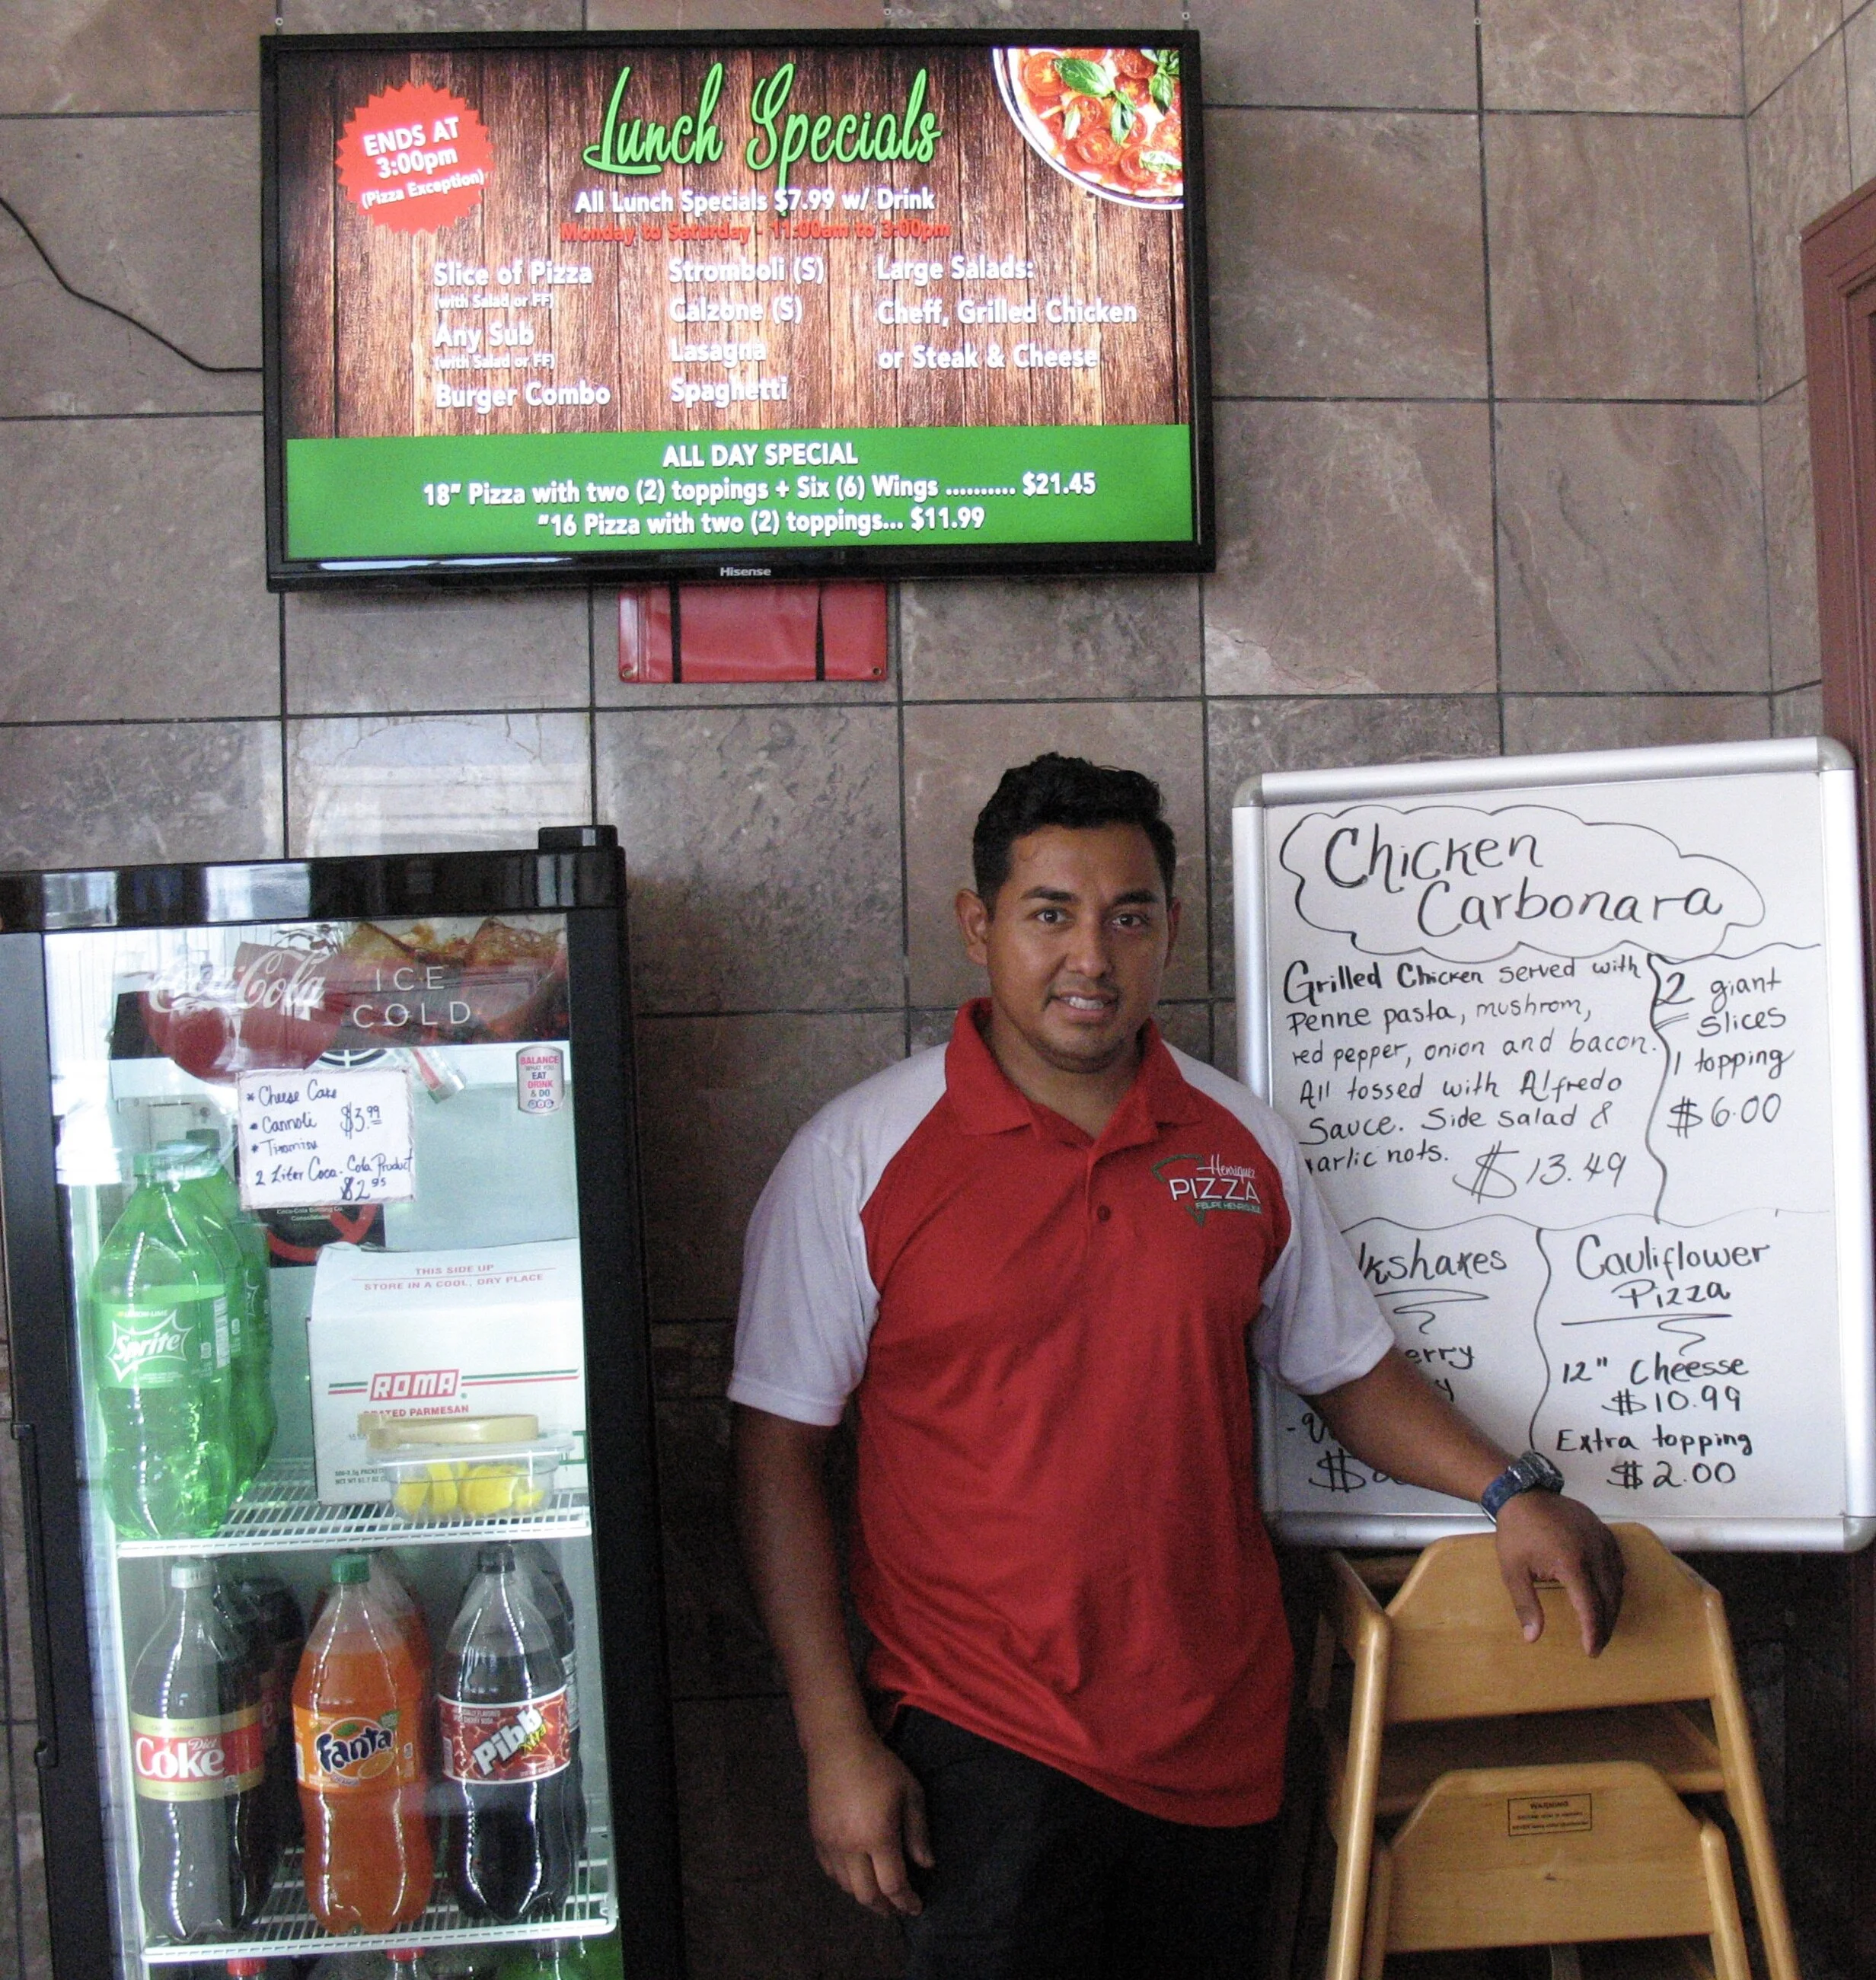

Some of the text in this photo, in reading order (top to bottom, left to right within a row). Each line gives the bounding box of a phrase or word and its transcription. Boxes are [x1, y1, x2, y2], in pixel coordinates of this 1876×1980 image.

[363, 116, 460, 158] ENDS AT
[583, 62, 941, 217] Lunch Specials
[376, 147, 458, 180] 3:00pm
[361, 170, 484, 209] (Pizza Exception)
[575, 187, 935, 216] All Lunch Specials $7.99 w/ Drink
[562, 220, 951, 246] Monday to Saturday 11:00am to 3:00pm
[432, 260, 592, 287] Slice of Pizza
[668, 257, 825, 285] Stromboli (S)
[876, 255, 1035, 287] Large Salads:
[434, 292, 555, 311] (with Salad or FF)
[668, 294, 802, 324] Calzone (S)
[877, 298, 1137, 327] Cheff, Grilled Chicken
[434, 320, 534, 353] Any Sub
[434, 353, 556, 371] (with Salad or FF)
[670, 339, 767, 368] Lasagna
[879, 344, 1098, 370] or Steak & Cheese
[436, 381, 610, 414] Burger Combo
[670, 377, 787, 408] Spaghetti
[663, 442, 859, 468] ALL DAY SPECIAL
[468, 482, 525, 505] Pizza
[532, 480, 579, 505] with
[586, 480, 629, 503] two
[636, 479, 665, 505] (2)
[672, 477, 768, 506] toppings
[776, 483, 790, 498] +
[797, 475, 830, 499] Six
[837, 475, 865, 501] (6)
[872, 473, 939, 502] Wings
[1023, 471, 1096, 498] $21.45
[585, 513, 640, 537] Pizza
[648, 511, 694, 534] with
[701, 512, 744, 534] two
[751, 510, 780, 537] (2)
[911, 506, 985, 531] $11.99
[719, 566, 771, 576] Hisense
[1325, 824, 1543, 893] Chicken
[1417, 876, 1723, 937] Carbonara
[376, 966, 446, 991] ICE
[1283, 955, 1642, 1007] Grilled Chicken served with
[1657, 967, 1782, 1014] 2 giant
[353, 1000, 471, 1028] COLD
[1384, 998, 1466, 1035] pasta,
[520, 1056, 560, 1064] BALANCE
[1292, 1028, 1657, 1069] red pepper, onion and bacon.
[1674, 1047, 1795, 1080] 1 topping
[259, 1085, 299, 1106] Cheese
[1300, 1068, 1622, 1109] All tossed with Alfredo
[263, 1111, 317, 1133] Cannoli
[1421, 1107, 1487, 1132] Side
[1667, 1092, 1782, 1139] $6.00
[1305, 1145, 1377, 1176] arlic
[1387, 1140, 1449, 1165] nots.
[255, 1170, 266, 1185] 2
[271, 1164, 304, 1183] Liter
[1169, 1178, 1261, 1204] PIZZA
[416, 1267, 442, 1275] THIS
[478, 1264, 495, 1273] UP
[1358, 1238, 1508, 1285] lkshakes
[1576, 1234, 1770, 1280] Cauliflower
[364, 1281, 404, 1290] STORE
[436, 1278, 471, 1288] COOL,
[477, 1277, 501, 1286] DRY
[506, 1274, 544, 1283] PLACE
[1611, 1279, 1731, 1309] Pizza
[114, 1333, 181, 1362] Sprite
[372, 1371, 458, 1400] ROMA
[1562, 1357, 1608, 1384] 12"
[410, 1404, 469, 1416] PARMESAN
[1602, 1385, 1741, 1416] $10.99
[1557, 1424, 1753, 1456] Extra topping
[1607, 1461, 1736, 1489] $2.00
[188, 1738, 217, 1750] Diet
[314, 1727, 394, 1774] Fanta
[473, 1708, 543, 1775] Pibb
[136, 1737, 225, 1778] Coke
